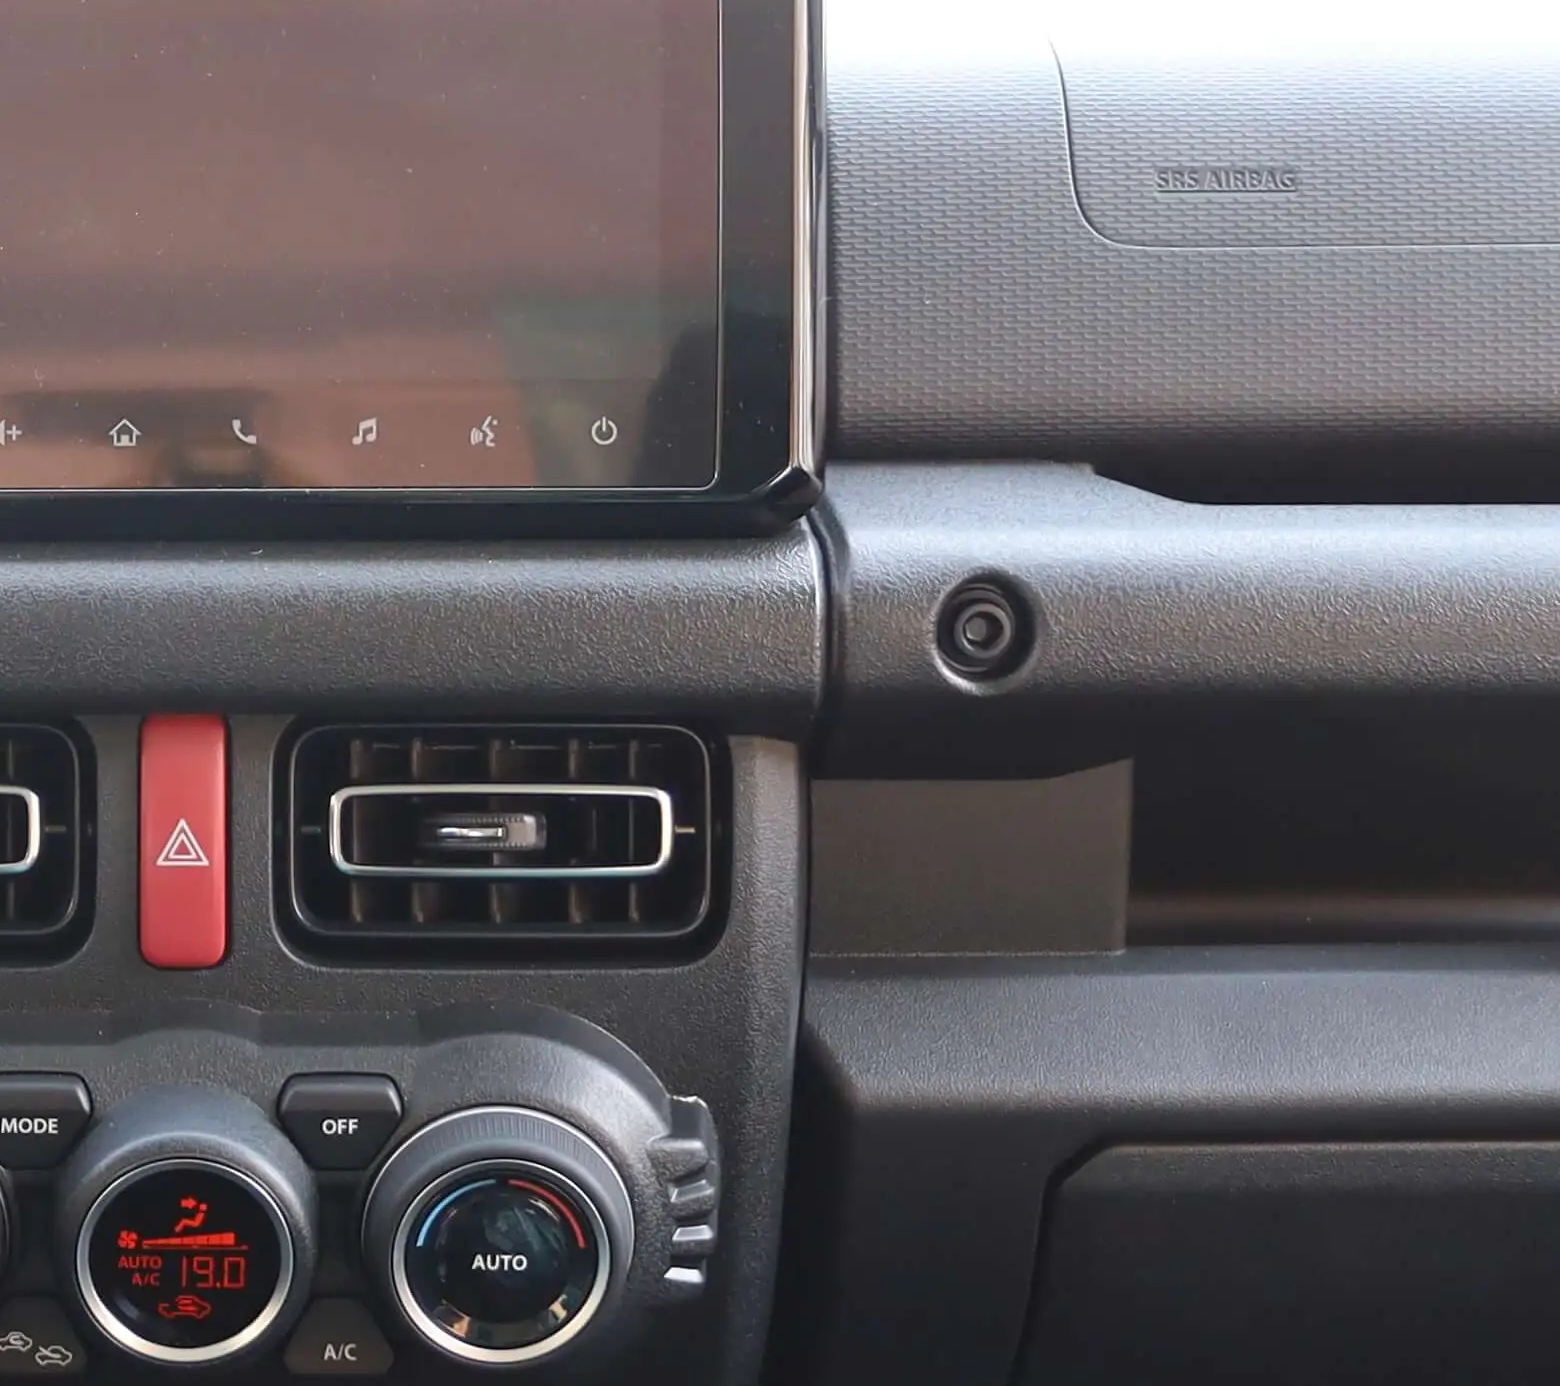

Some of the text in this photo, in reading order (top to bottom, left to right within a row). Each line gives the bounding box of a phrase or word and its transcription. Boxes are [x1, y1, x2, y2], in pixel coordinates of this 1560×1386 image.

[1155, 169, 1296, 190] SRS AIRBAG
[0, 1117, 59, 1135] MODE
[322, 1119, 358, 1135] OFF
[118, 1256, 163, 1269] AUTO
[471, 1254, 528, 1271] AUTO
[131, 1272, 161, 1286] A/C
[181, 1256, 246, 1288] 19.0
[323, 1343, 358, 1361] A/C
